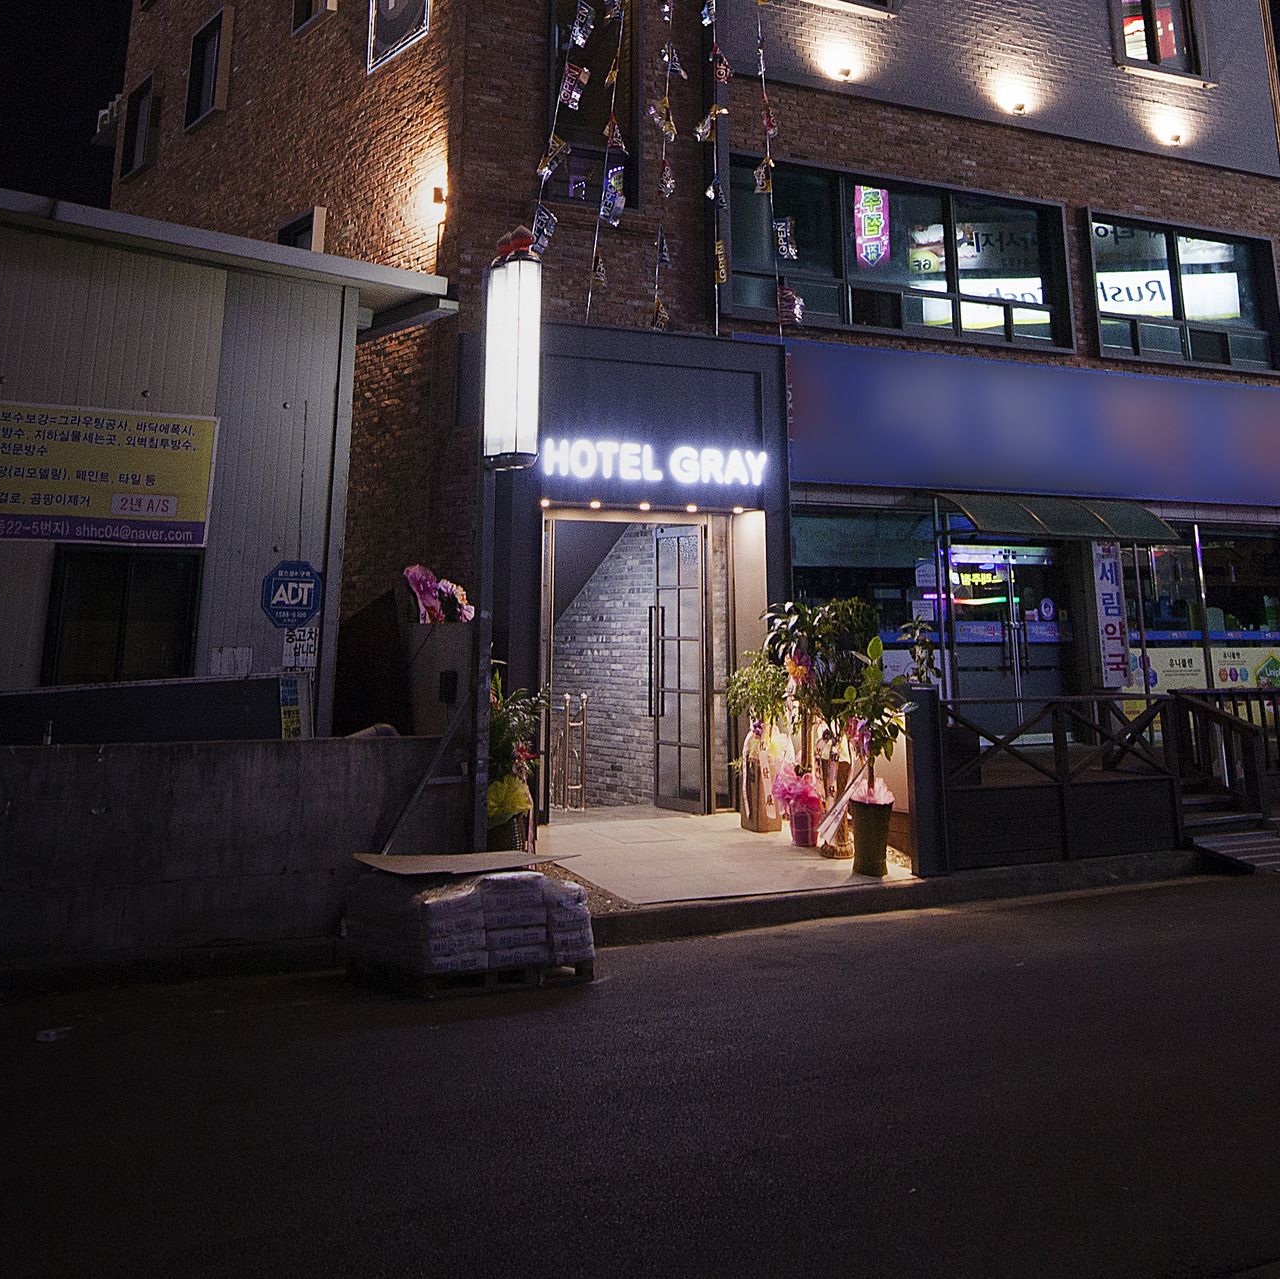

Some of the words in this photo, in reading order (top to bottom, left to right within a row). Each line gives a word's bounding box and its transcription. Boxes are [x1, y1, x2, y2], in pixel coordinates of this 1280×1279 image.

[543, 438, 664, 482] HOTEL
[670, 445, 768, 487] GRAY
[120, 496, 143, 512] 2년
[146, 497, 170, 513] A/S
[75, 525, 193, 542] shhc04@naver.com
[271, 581, 315, 606] ADT
[1100, 561, 1130, 679] 세림약국
[285, 627, 318, 643] 중고차
